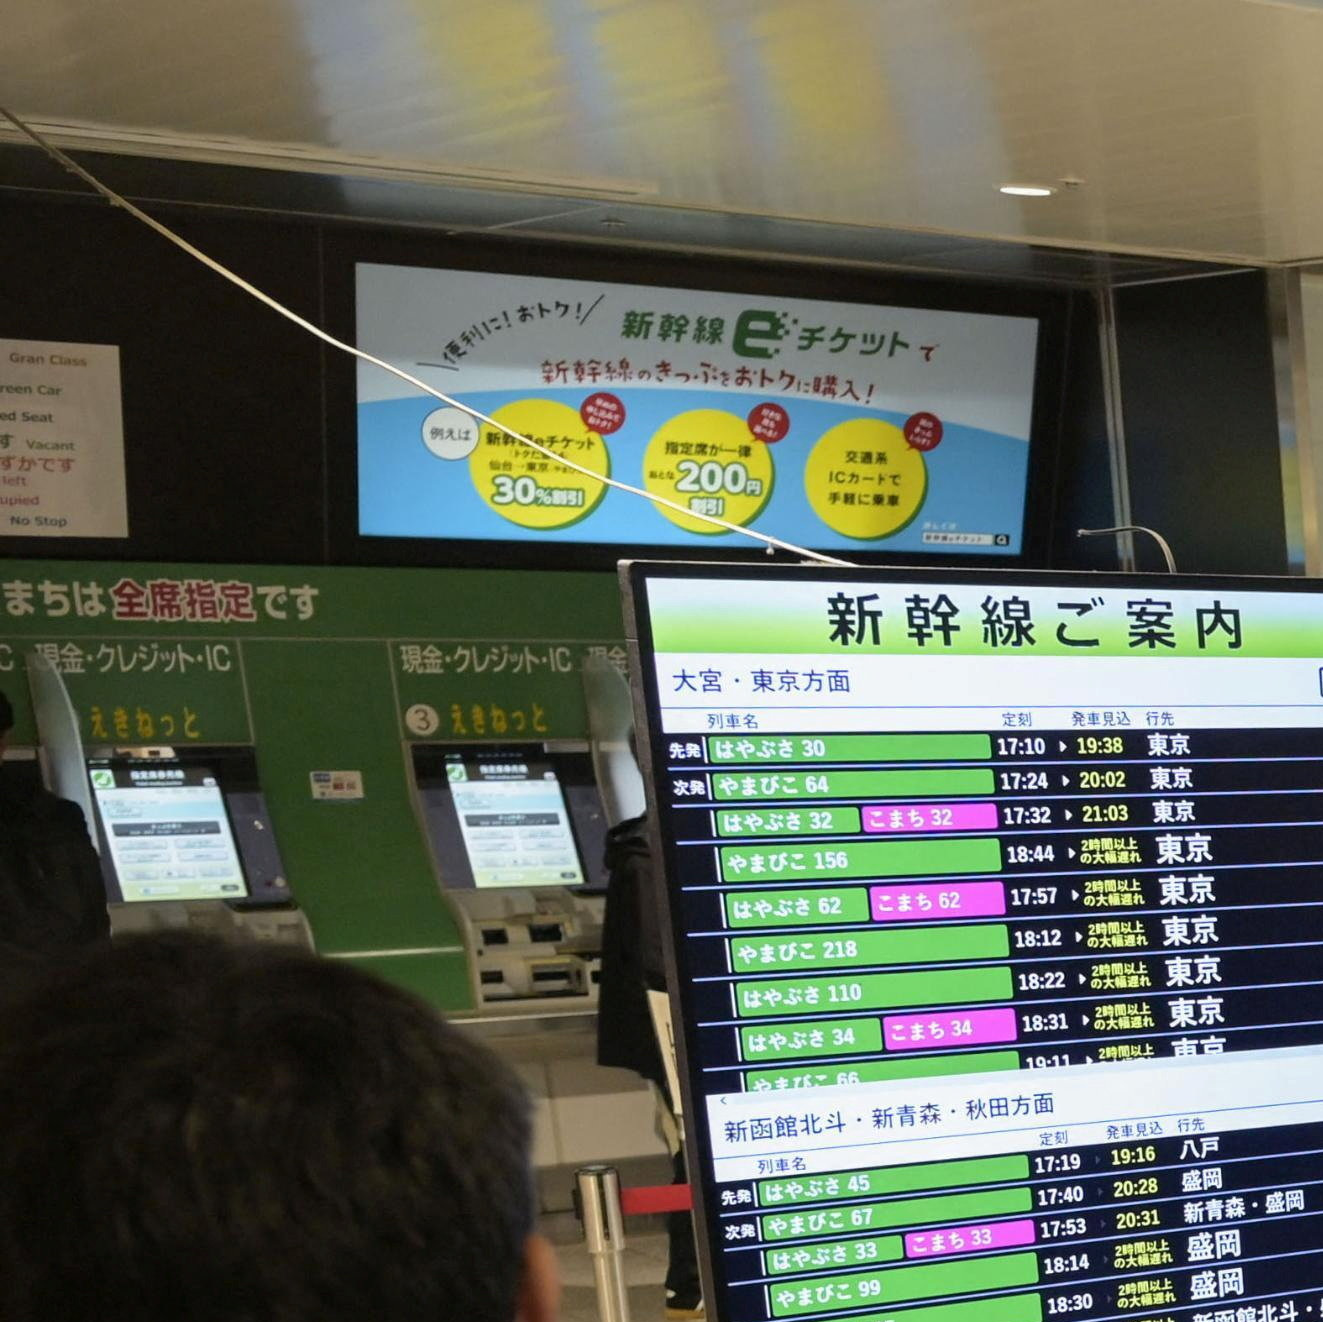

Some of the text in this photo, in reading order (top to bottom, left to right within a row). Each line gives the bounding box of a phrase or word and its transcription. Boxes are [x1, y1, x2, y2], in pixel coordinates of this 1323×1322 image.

[37, 384, 63, 396] Car
[21, 412, 54, 423] Seat
[845, 450, 888, 465] 交通系
[829, 471, 901, 486] ICカードで
[10, 515, 68, 528] No Stop
[826, 593, 1243, 649] 新幹線ご案内
[673, 669, 851, 693] 大宮・東京方面
[92, 706, 200, 738] えきねっと
[452, 704, 548, 734] えきねっと
[707, 712, 1175, 729] 列車名 定刻 発車見込 行先
[670, 742, 701, 759] 先発
[716, 740, 794, 758] はやぶさ
[802, 740, 825, 757] 30
[998, 738, 1045, 755] 17:10
[1077, 737, 1123, 754] 19:38
[1147, 733, 1191, 756] 東京
[1081, 838, 1138, 851] 2時間以上
[738, 942, 816, 963] やまびこ
[823, 941, 858, 959] 218
[1015, 929, 1062, 948] 18:12
[1162, 915, 1219, 947] 東京
[724, 1091, 1054, 1144] 新函館北斗・新青森・秋田方面
[758, 1119, 1205, 1174] 列車名 定刻 発車見込 行先
